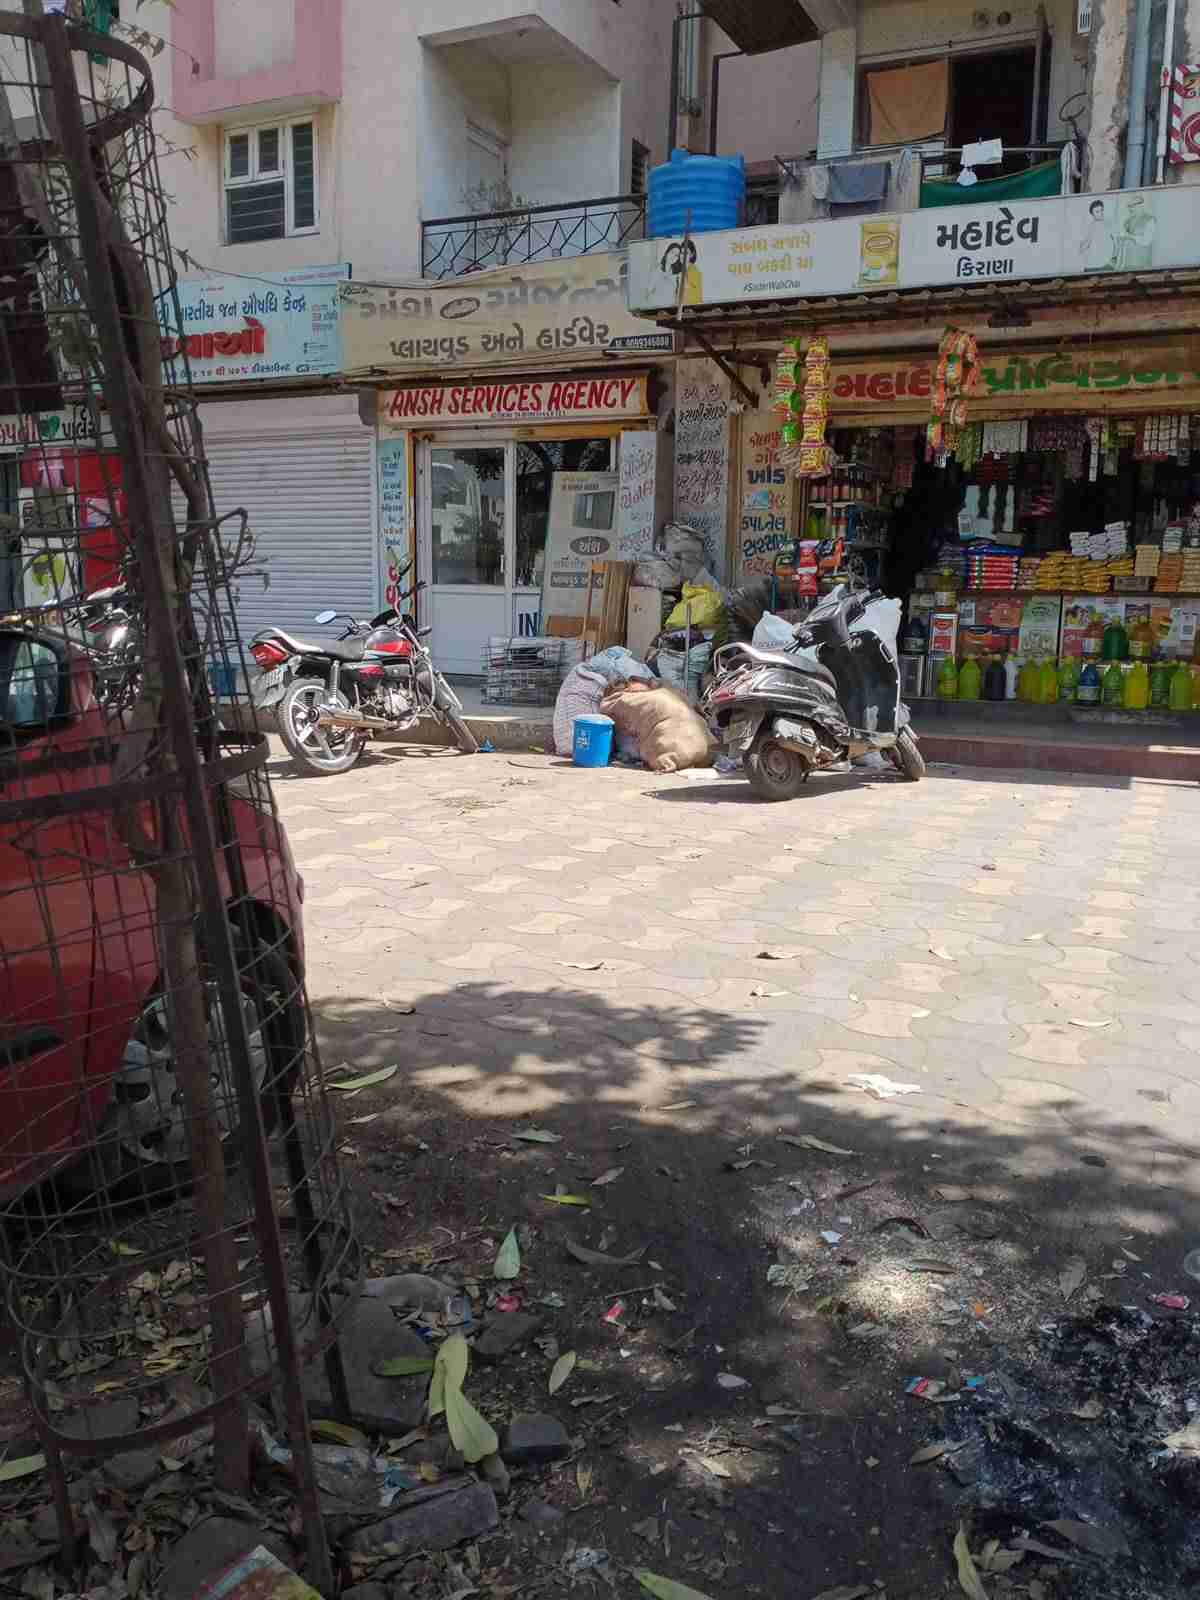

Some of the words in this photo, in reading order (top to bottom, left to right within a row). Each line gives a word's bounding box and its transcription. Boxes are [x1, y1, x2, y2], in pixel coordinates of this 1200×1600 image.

[936, 207, 1040, 251] મહાદેવ
[956, 256, 1015, 277] કિરાણા
[219, 303, 238, 319] જન
[389, 335, 470, 363] પ્લાયવુડ
[480, 323, 524, 352] અને
[536, 315, 610, 350] હાર્ડવેર
[389, 387, 445, 417] ANSH
[449, 382, 543, 415] SERVICES
[546, 379, 637, 409] AGENCY
